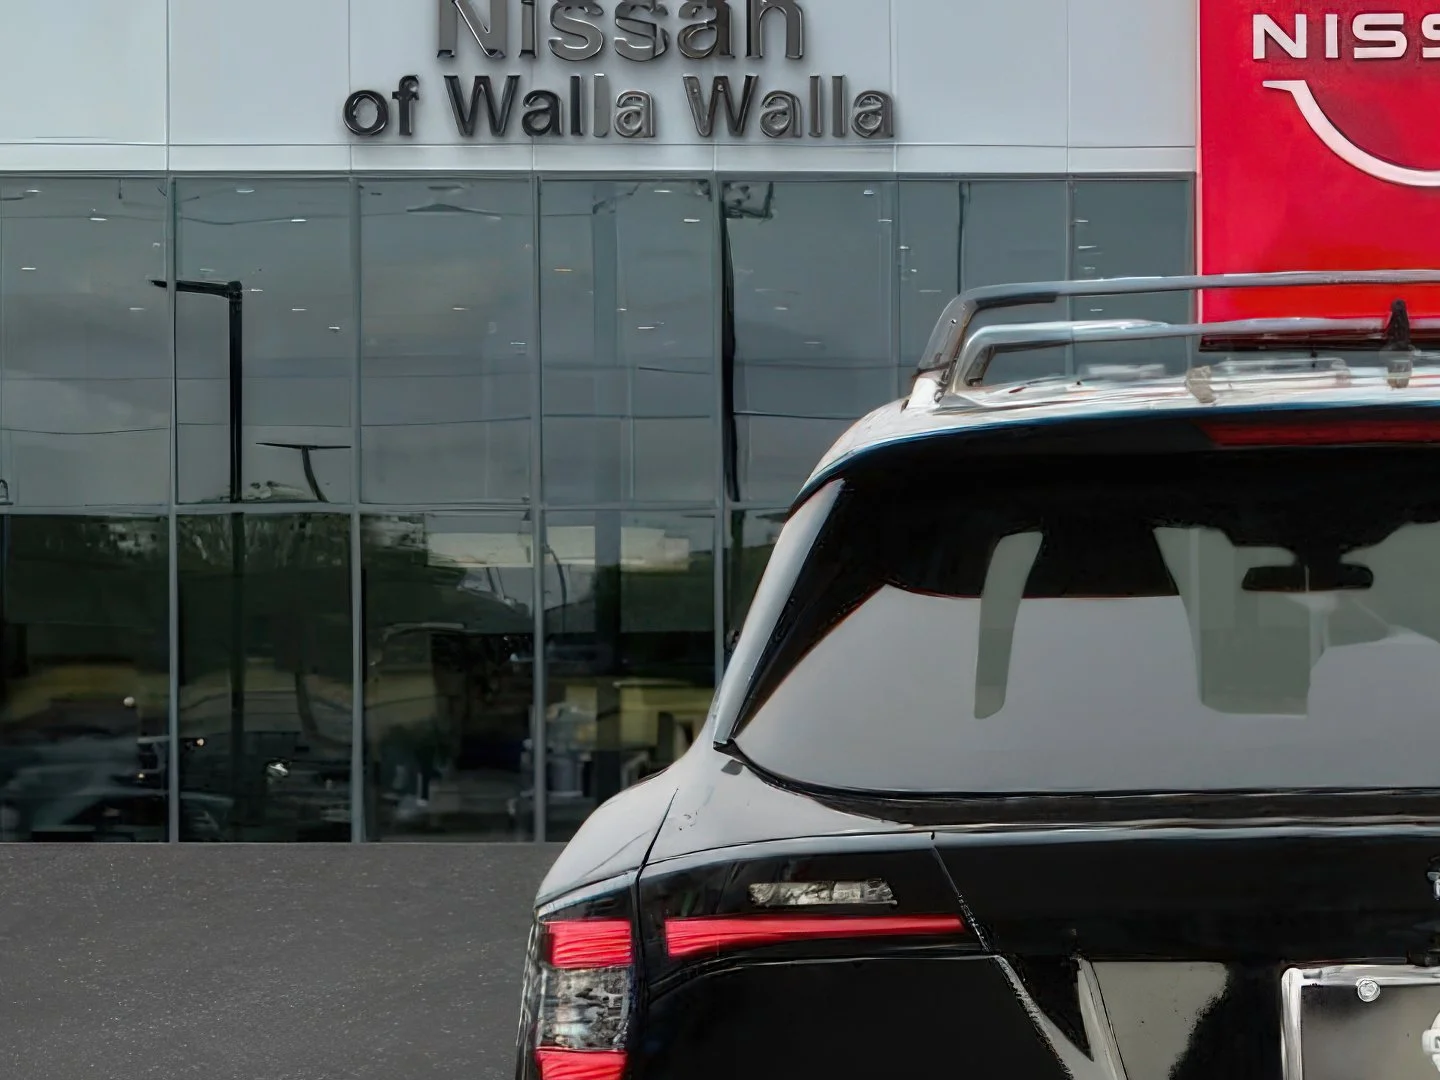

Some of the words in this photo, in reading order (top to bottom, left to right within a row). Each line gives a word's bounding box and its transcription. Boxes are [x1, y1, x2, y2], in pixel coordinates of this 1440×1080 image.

[342, 74, 420, 138] of
[443, 74, 656, 138] Walla
[682, 74, 895, 138] Walla
